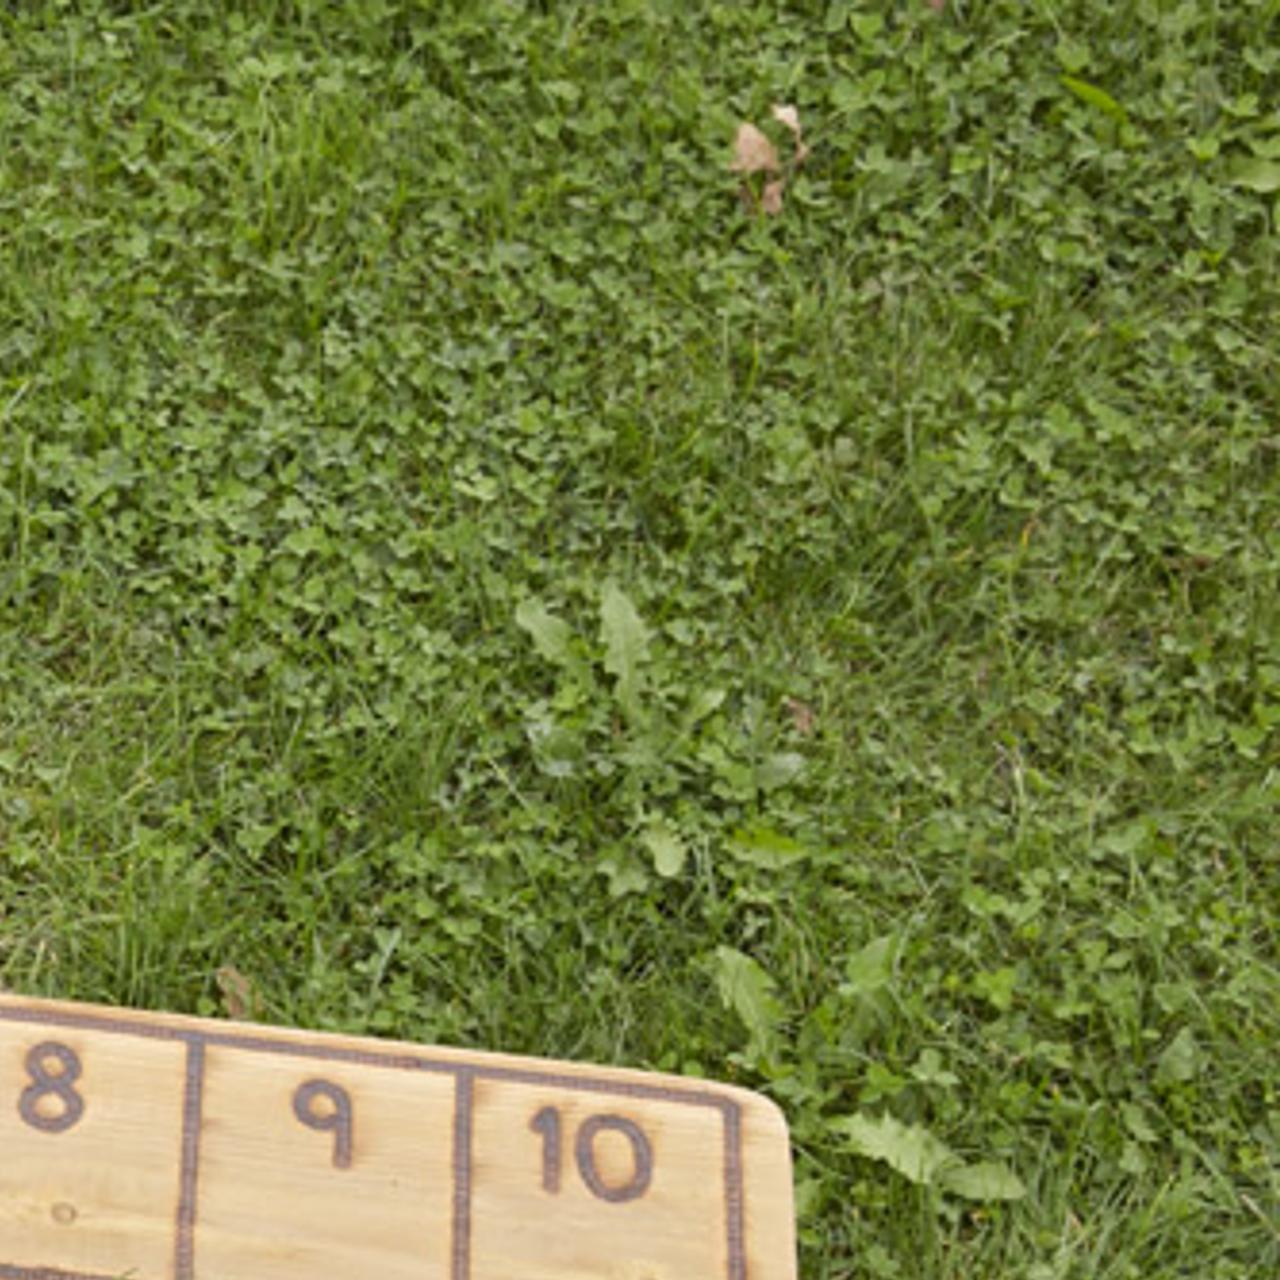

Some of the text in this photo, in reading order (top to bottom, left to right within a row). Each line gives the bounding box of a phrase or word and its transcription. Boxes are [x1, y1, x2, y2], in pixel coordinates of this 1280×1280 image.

[17, 1040, 85, 1134] 8
[291, 1078, 356, 1170] 9
[529, 1108, 654, 1203] 10
